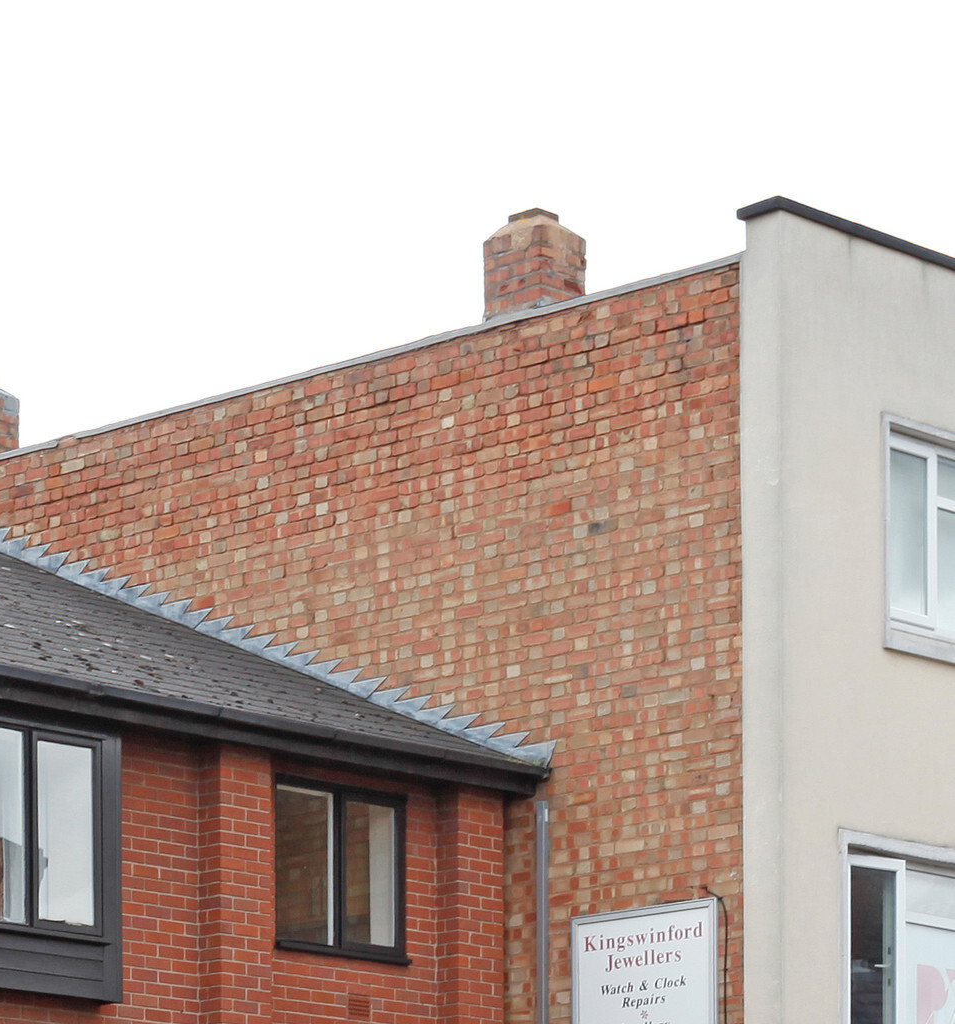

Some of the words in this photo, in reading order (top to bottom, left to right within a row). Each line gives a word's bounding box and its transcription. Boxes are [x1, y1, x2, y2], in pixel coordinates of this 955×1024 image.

[584, 921, 703, 953] Kingswinford
[605, 948, 682, 972] Jewellers
[601, 981, 634, 996] Watch
[639, 978, 649, 991] &
[655, 975, 686, 989] Clock
[621, 993, 666, 1010] Repairs
